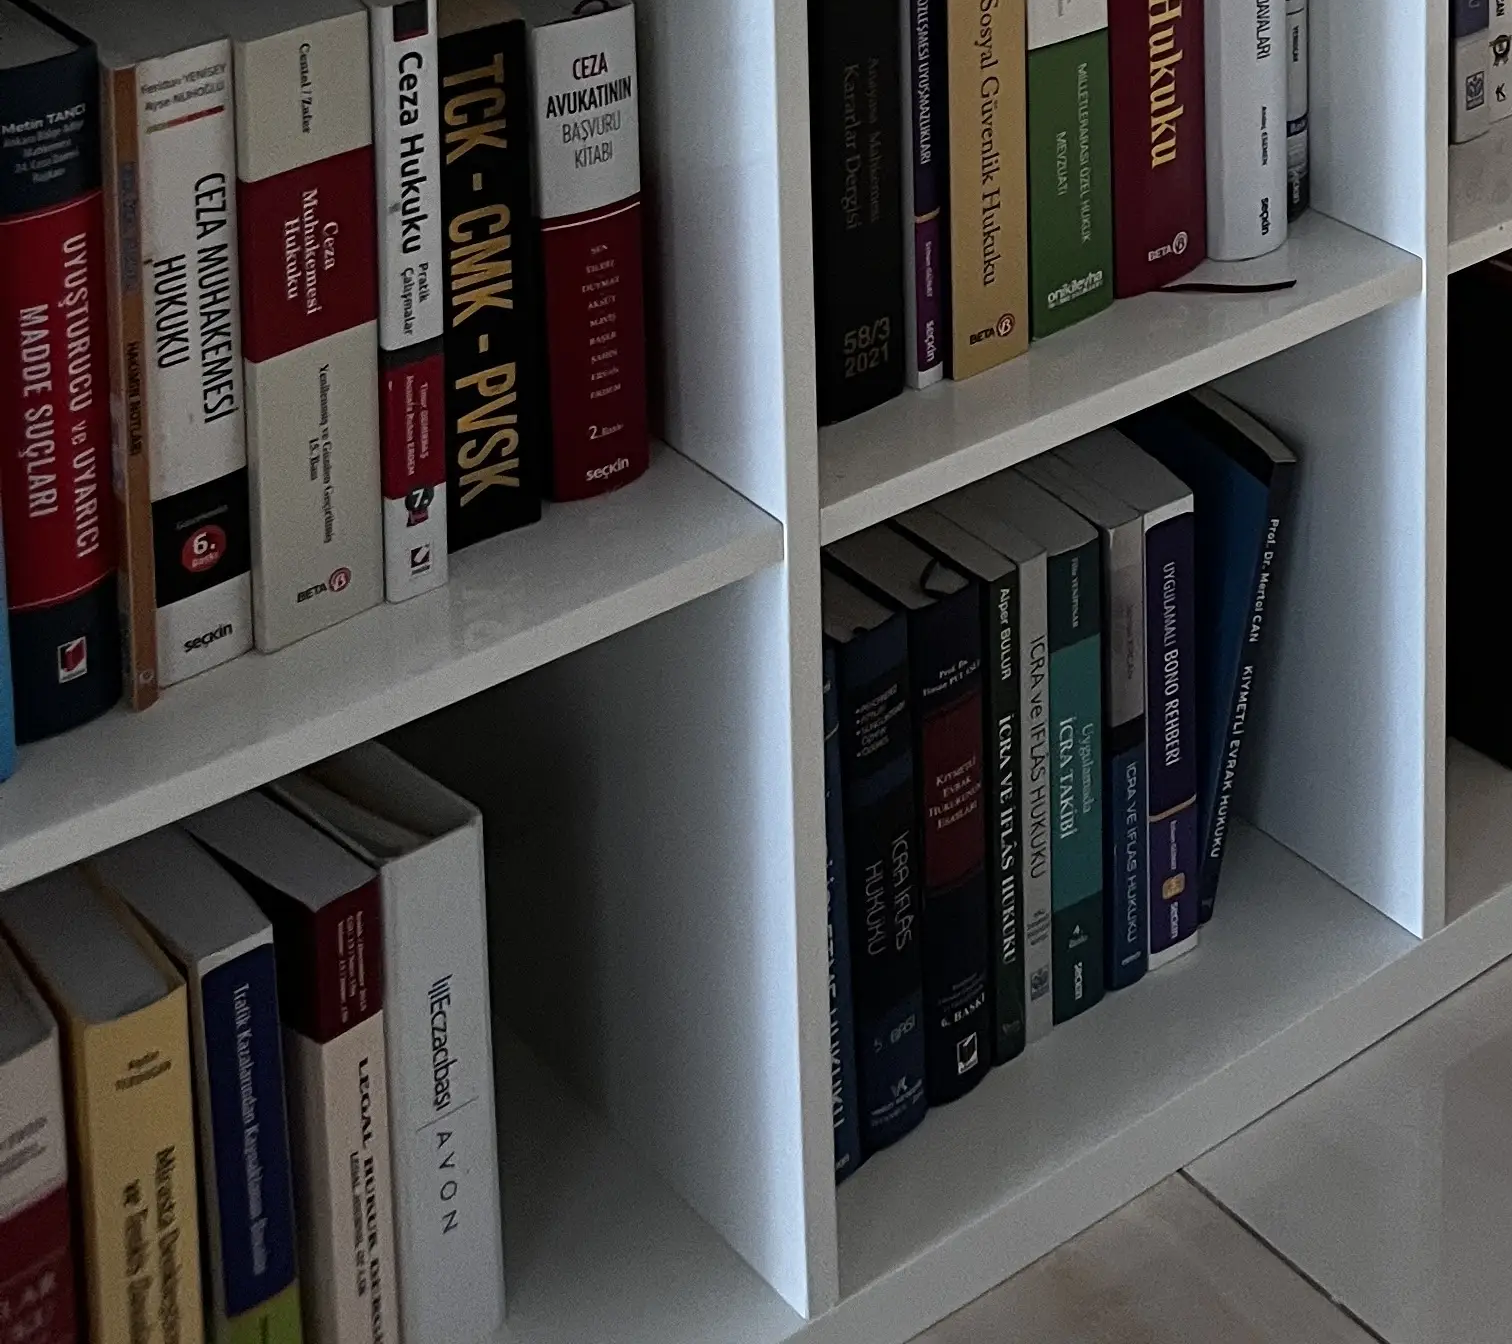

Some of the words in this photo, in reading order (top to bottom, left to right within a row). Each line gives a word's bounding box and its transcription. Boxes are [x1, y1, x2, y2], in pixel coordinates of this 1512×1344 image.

[398, 51, 423, 126] Ceza
[545, 75, 632, 120] AVUKATININ
[571, 52, 609, 81] CEZA
[443, 52, 508, 166] TCK
[560, 109, 622, 145] BAŞVURU
[843, 63, 862, 149] Kararlar
[979, 74, 1001, 181] Güvenlik
[574, 140, 614, 170] KİTABI
[1055, 131, 1068, 196] MEVZUATI
[194, 172, 228, 241] CEZA
[400, 132, 429, 256] Hukuku
[840, 153, 863, 230] Dergisi
[1259, 197, 1270, 237] seçkin
[284, 216, 301, 302] Hukuku
[301, 187, 323, 317] Muhakemesi
[323, 221, 340, 272] Ceza
[448, 203, 514, 329] CMK
[981, 185, 1002, 285] Hukuku
[1148, 244, 1172, 262] BETA
[153, 253, 191, 370] HUKUKU
[399, 265, 415, 336] Çalışmalar
[418, 261, 431, 303] Pratik
[19, 303, 53, 398] MADDE
[57, 231, 93, 413] UYUŞTURUCU
[197, 242, 240, 424] MUHAKEMESİ
[844, 316, 891, 355] 58/3
[969, 327, 995, 346] BETA
[844, 343, 890, 379] 2021
[17, 402, 59, 519] SUÇLARI
[69, 419, 87, 445] ve
[454, 360, 521, 509] PVSK
[412, 488, 430, 508] 7.
[585, 457, 630, 482] seçkin
[70, 446, 101, 559] UYARICI
[1264, 518, 1281, 548] Prof.
[192, 531, 217, 555] 6.
[1261, 550, 1275, 571] Dr.
[297, 582, 327, 603] BETA
[997, 587, 1010, 625] Alper
[1162, 561, 1177, 648] UYGULAMALI
[1253, 572, 1270, 612] Mertol
[183, 623, 234, 654] seçkin
[998, 628, 1012, 680] BULUR
[1248, 613, 1263, 643] CAN
[1030, 690, 1044, 720] ve
[1164, 648, 1179, 698] BONO
[1231, 665, 1255, 735] KIYMETLİ
[998, 713, 1015, 771] İCRA
[1059, 716, 1078, 769] İCRA
[1164, 698, 1181, 768] REHBERİ
[1221, 738, 1243, 792] EVRAK
[1000, 772, 1013, 804] VE
[1079, 722, 1095, 814] Uygulamada
[1030, 784, 1047, 879] HUKUKU
[1059, 769, 1078, 840] TAKİBİ
[1126, 800, 1137, 826] VE
[1209, 793, 1232, 858] HUKUKU
[1000, 805, 1018, 871] İFLÂS
[865, 858, 888, 957] HUKUKU
[1001, 875, 1016, 964] HUKUKU
[1126, 874, 1138, 943] HUKUKU
[232, 982, 252, 1029] Trafik
[953, 992, 986, 1023] BASKI
[358, 1056, 374, 1150] LEGAL
[364, 1155, 379, 1252] HUKUK
[435, 1130, 459, 1236] AVON
